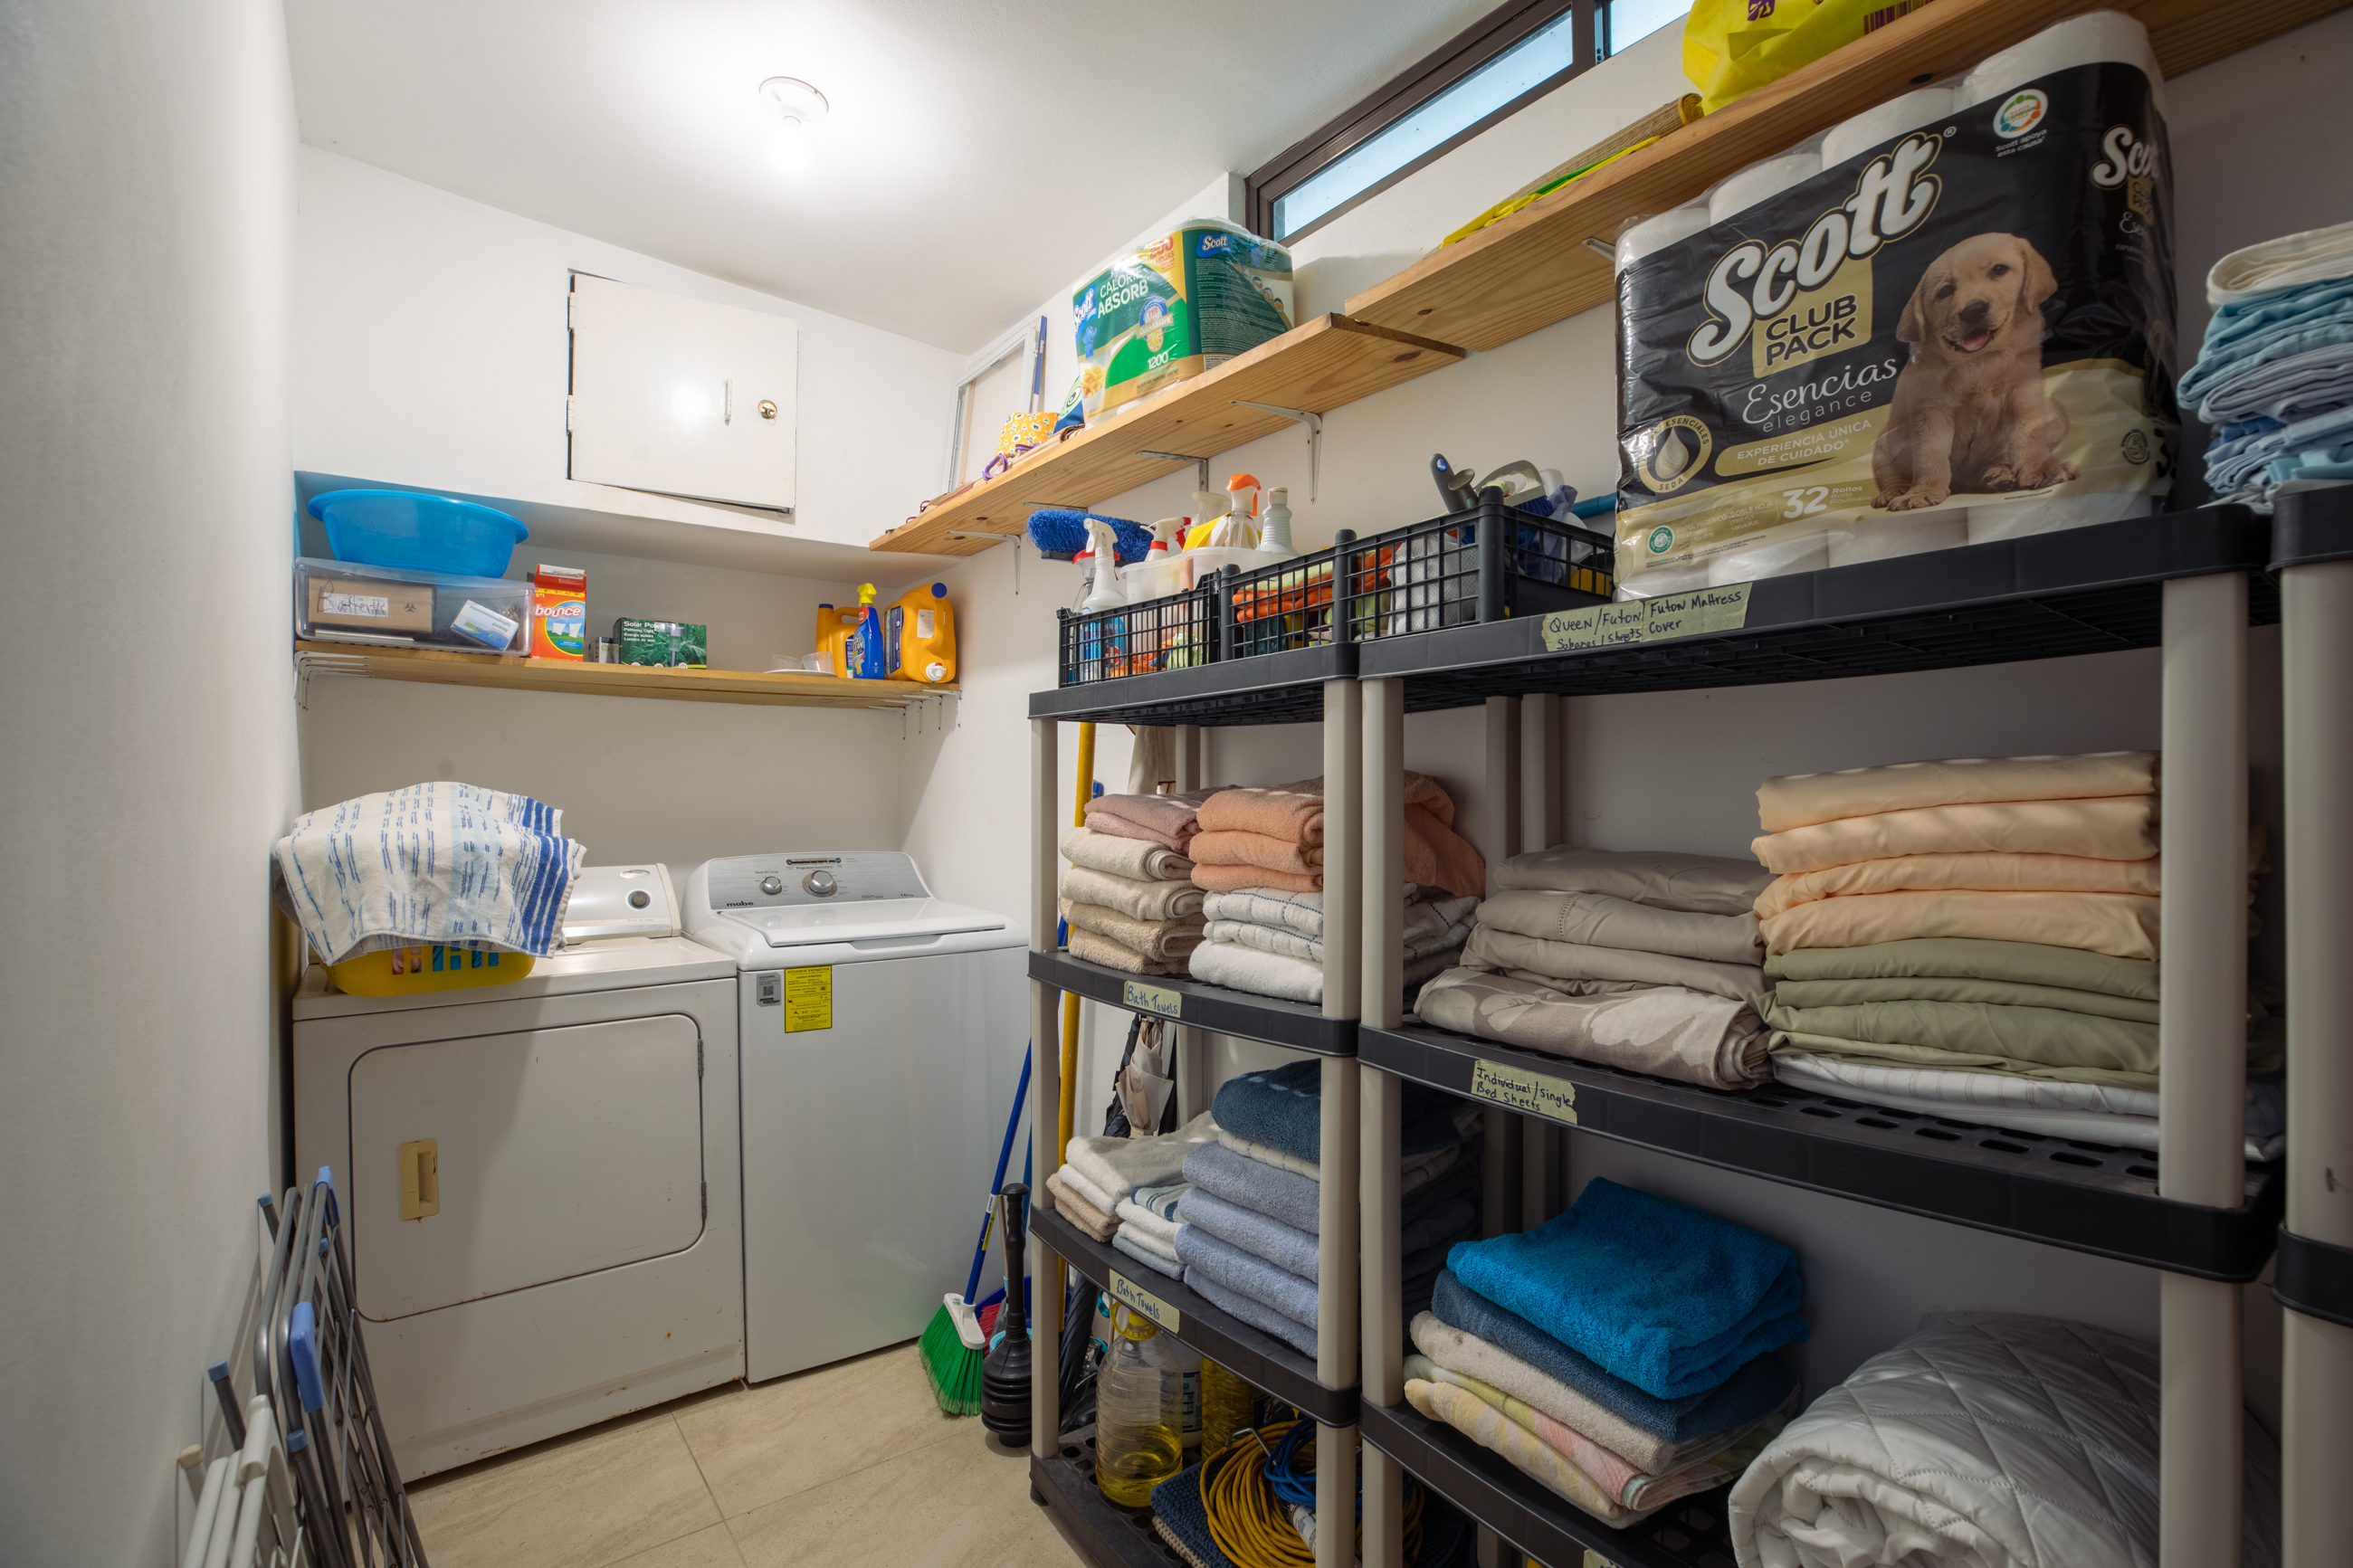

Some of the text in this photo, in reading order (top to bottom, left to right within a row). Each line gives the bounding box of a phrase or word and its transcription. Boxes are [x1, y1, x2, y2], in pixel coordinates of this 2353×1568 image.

[1996, 128, 2047, 152] Scott apoya
[1997, 147, 2015, 157] esta
[1202, 234, 1227, 252] Scott
[1689, 136, 1938, 363] Scott
[1098, 279, 1149, 319] ABSORB
[1765, 294, 1857, 341] CLUB
[1766, 317, 1856, 366] PACK
[1148, 350, 1169, 370] 1200
[1742, 358, 1897, 424] Esencias
[1763, 390, 1872, 432] elegance
[1665, 417, 1710, 445] ESENCIALES
[1737, 419, 1872, 460] EXPERIENCIA ÚNICA
[1758, 455, 1776, 466] DE
[1659, 477, 1684, 490] SEDA
[1831, 491, 1853, 499] Rolls
[1832, 485, 1863, 493] Rollos
[1730, 500, 1774, 518] DOBLE HOJA
[1782, 486, 1829, 519] 32
[1830, 494, 1872, 506] Rouleaux
[1676, 523, 1696, 534] PAPEL
[535, 603, 582, 618] bounce
[1649, 620, 1682, 634] Cover
[1127, 984, 1178, 1014] Bath Towels
[1476, 1080, 1540, 1112] Bed Sheets
[1137, 1292, 1160, 1320] Towels
